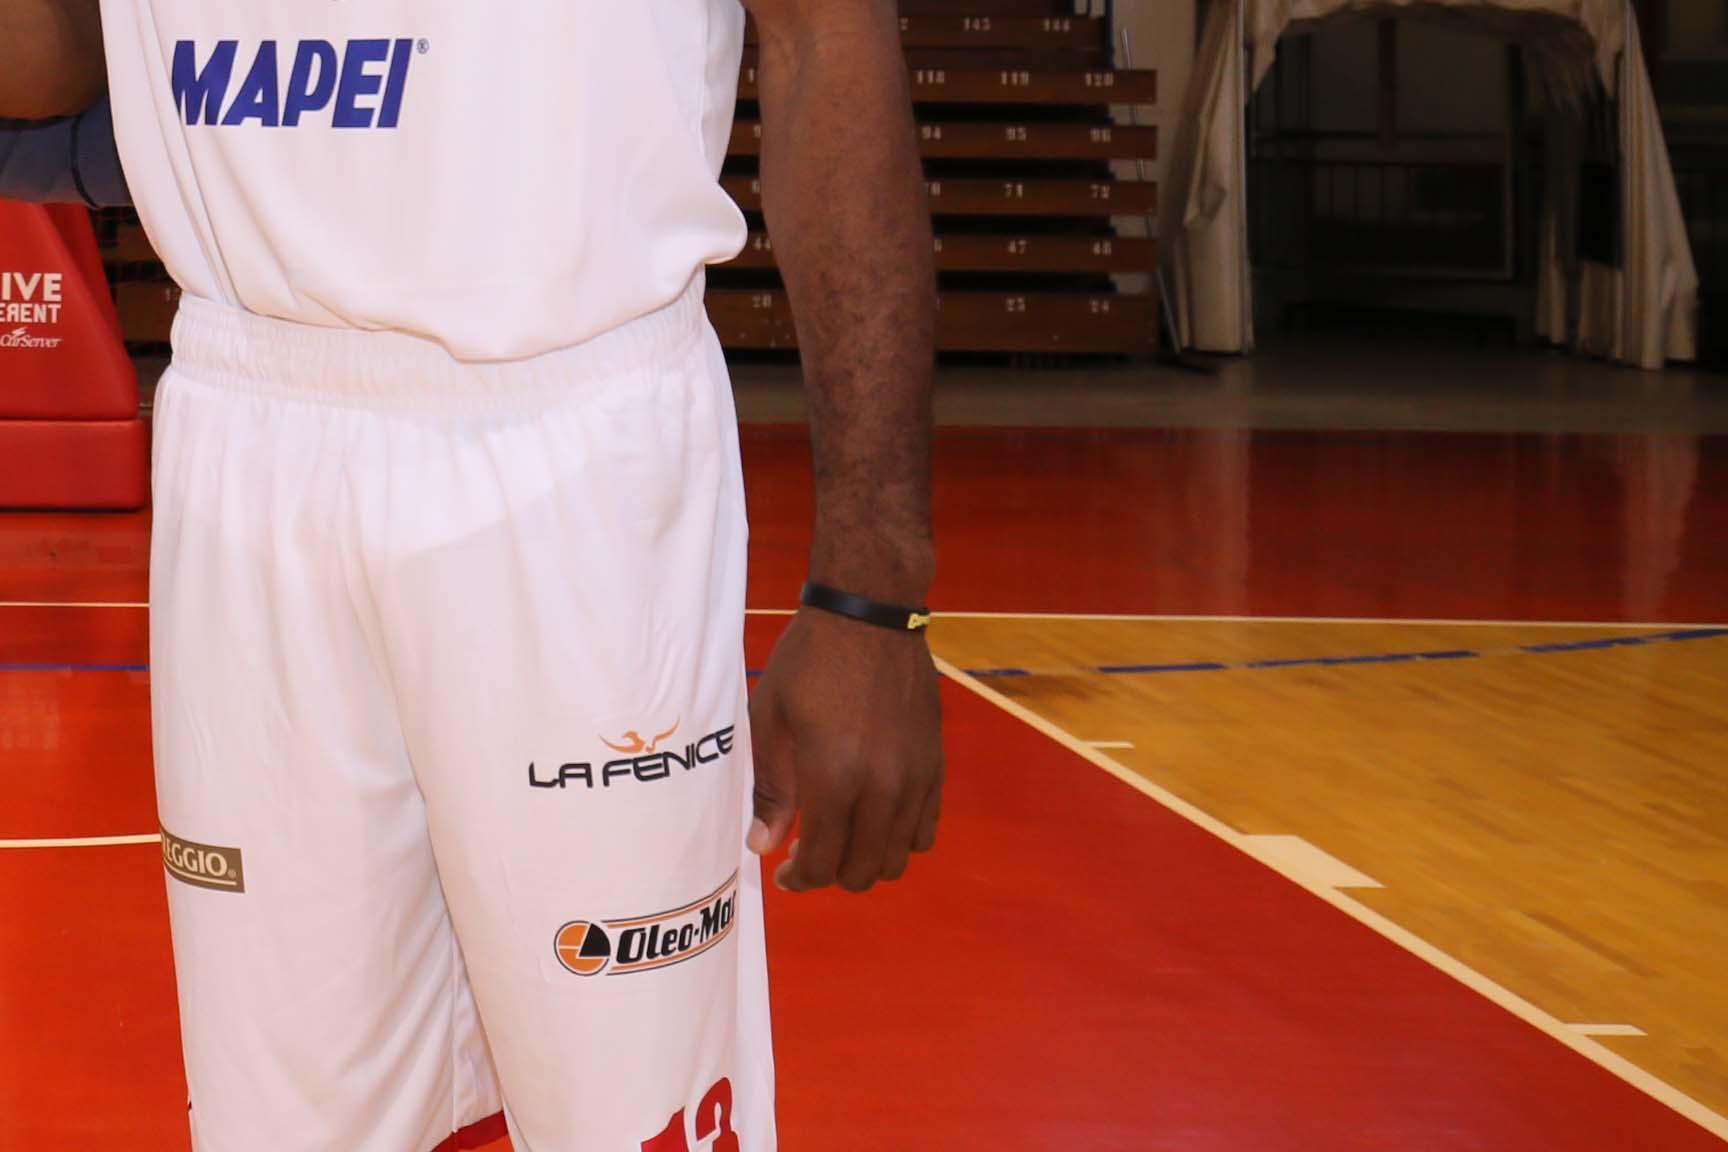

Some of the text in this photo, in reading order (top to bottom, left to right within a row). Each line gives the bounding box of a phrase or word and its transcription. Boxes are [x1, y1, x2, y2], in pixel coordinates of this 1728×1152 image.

[172, 38, 413, 129] MAPEI
[0, 331, 62, 349] CarServer
[528, 724, 734, 789] LA FENICE
[616, 890, 737, 964] Oleo-Ma
